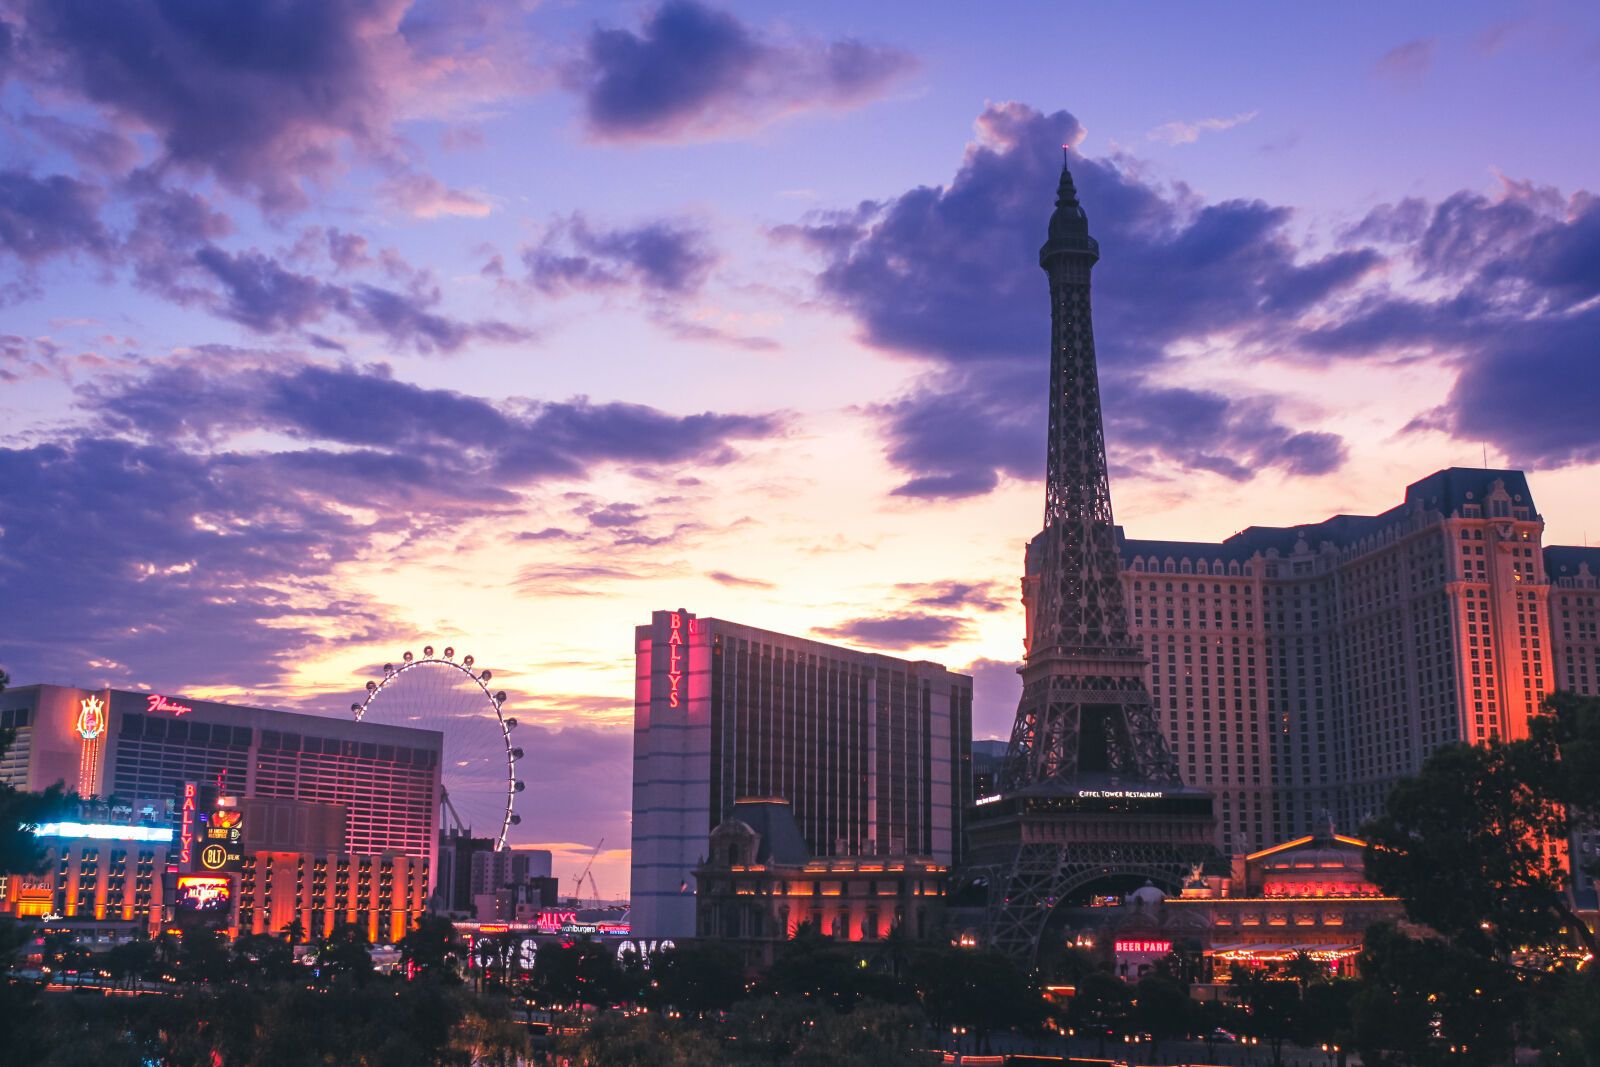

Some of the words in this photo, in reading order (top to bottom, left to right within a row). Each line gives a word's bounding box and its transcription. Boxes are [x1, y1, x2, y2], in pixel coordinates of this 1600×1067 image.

[146, 694, 192, 716] Flamingo
[1079, 790, 1100, 798] EIFFEL
[1101, 790, 1123, 798] TOWER
[1125, 790, 1162, 798] RESTAURANT
[207, 849, 222, 863] BLT
[561, 924, 596, 934] wahlburgers
[1115, 941, 1141, 952] BEER
[1143, 941, 1170, 952] PARK
